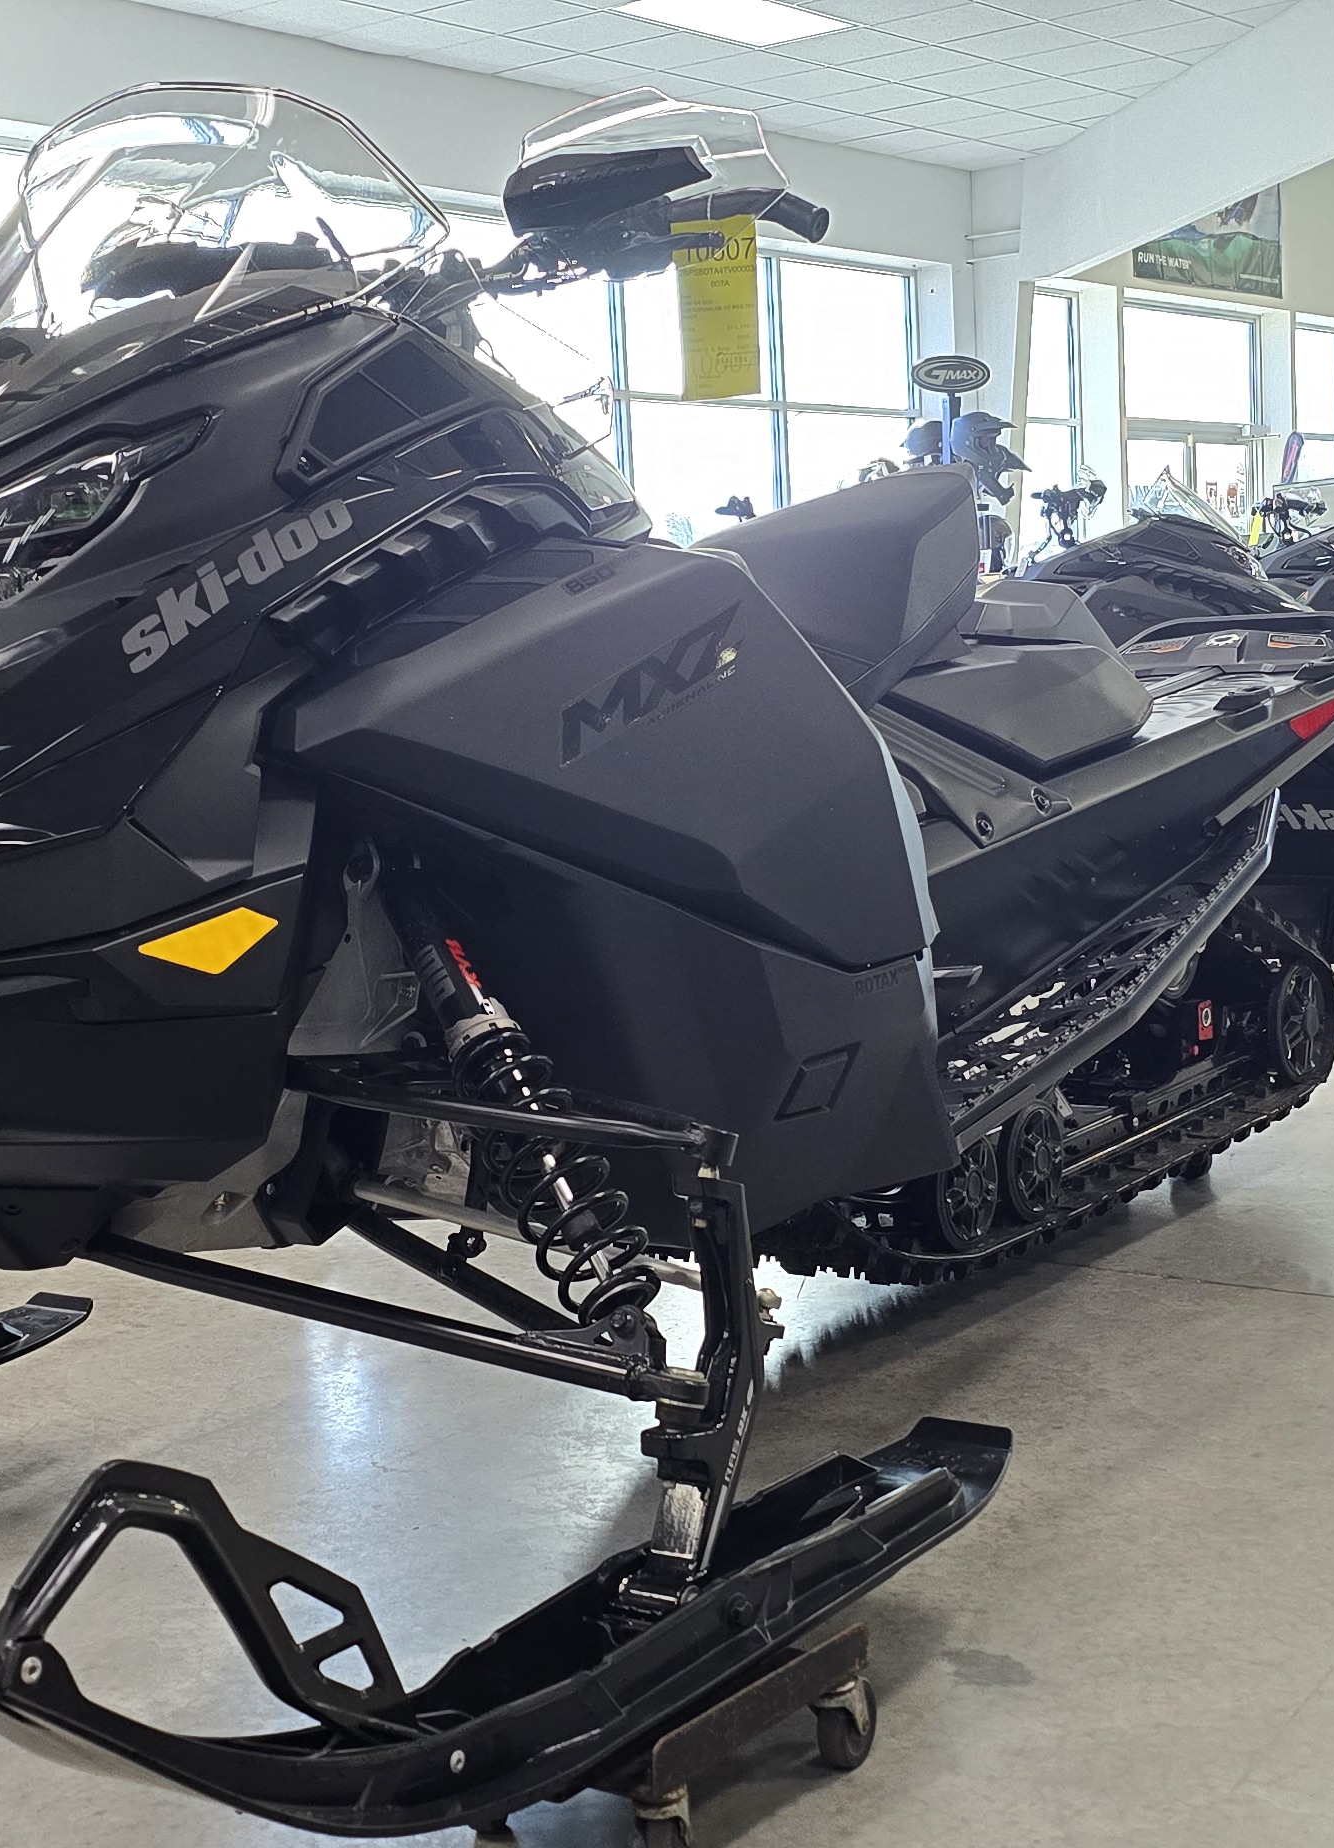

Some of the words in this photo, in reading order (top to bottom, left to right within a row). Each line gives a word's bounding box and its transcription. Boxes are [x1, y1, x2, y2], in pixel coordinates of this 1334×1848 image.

[1137, 251, 1155, 264] RUN
[917, 361, 980, 386] GMAX
[853, 967, 899, 999] ROTAX
